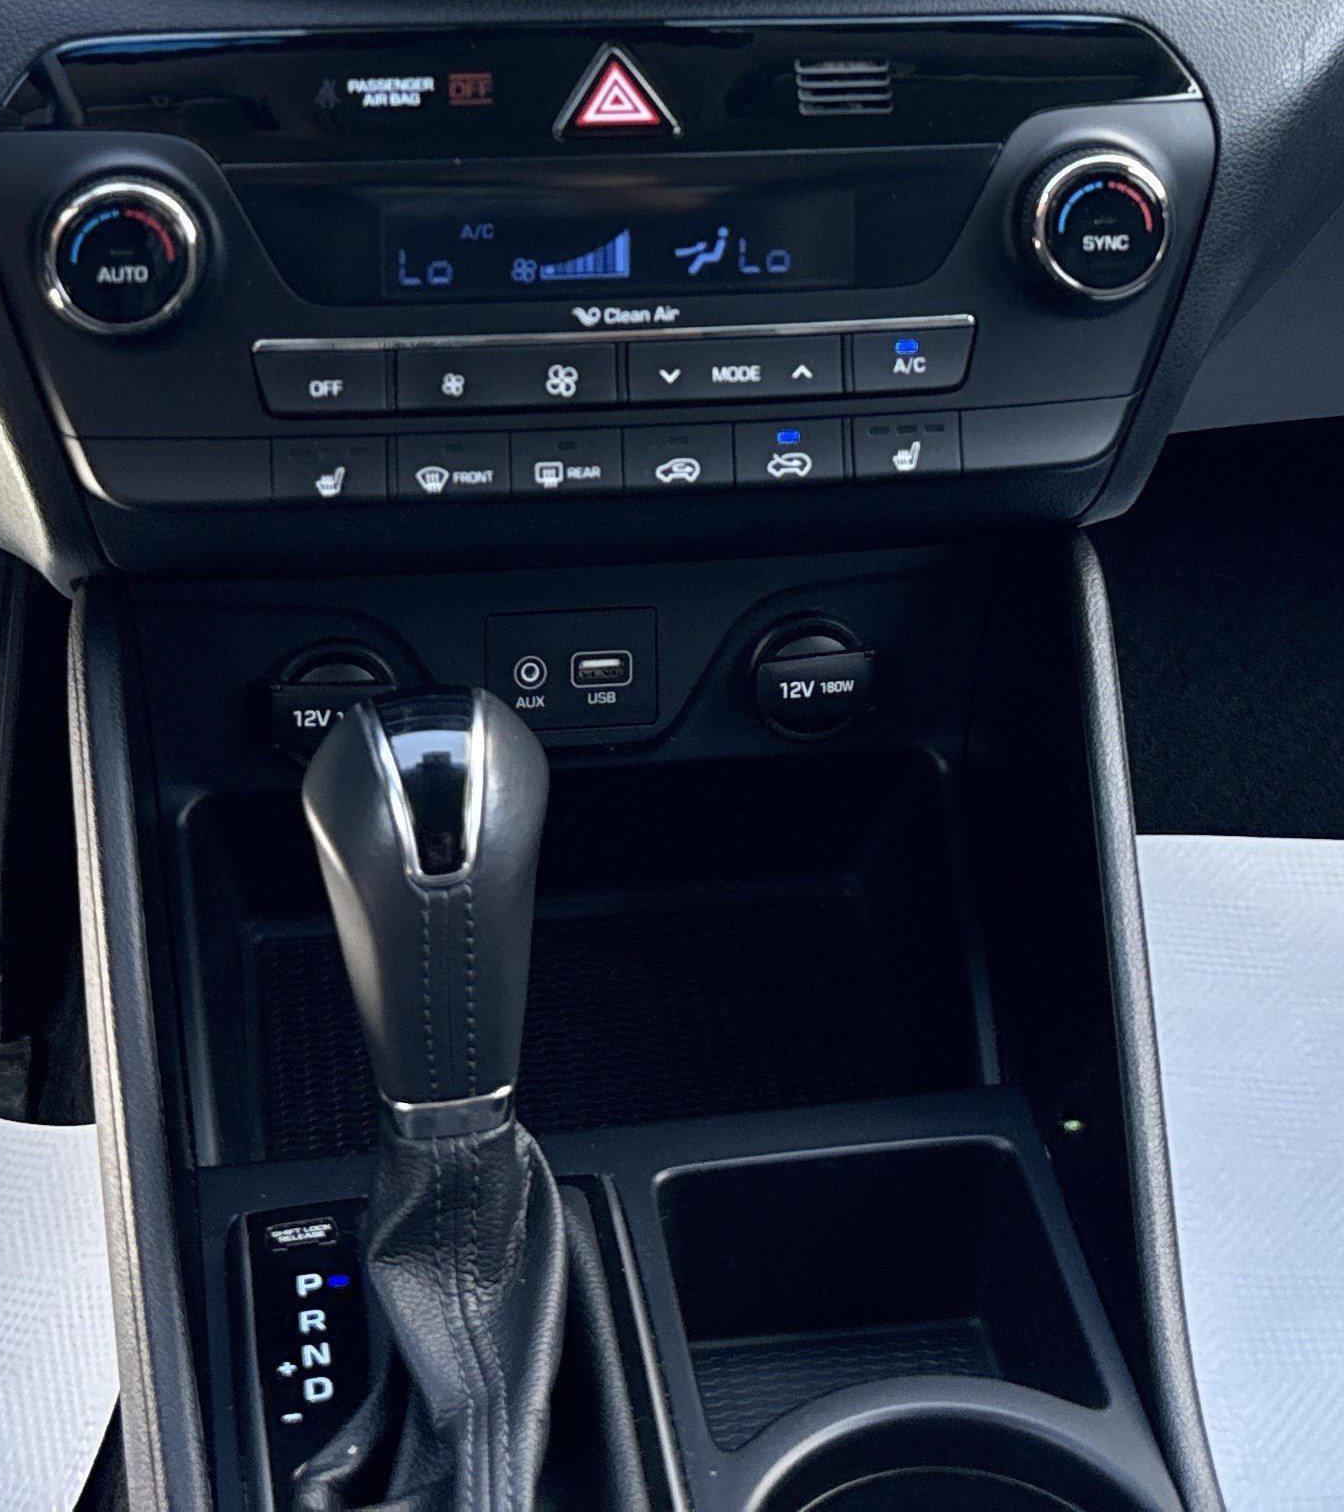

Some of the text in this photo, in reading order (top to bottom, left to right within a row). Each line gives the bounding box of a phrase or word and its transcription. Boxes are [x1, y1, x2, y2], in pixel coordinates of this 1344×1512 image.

[347, 77, 435, 94] PASSENGER
[362, 92, 421, 107] AIR BAG
[460, 224, 495, 240] A/C
[1082, 234, 1130, 252] SYNC
[96, 265, 149, 284] AUTO
[603, 306, 681, 324] Clean Air
[712, 365, 761, 383] MODE
[893, 357, 927, 375] A/C
[309, 379, 344, 397] OFF
[453, 469, 494, 484] FRONT
[567, 465, 602, 479] REAR
[586, 691, 617, 705] USB
[779, 679, 855, 699] 12V 180W
[515, 694, 545, 709] AUX
[293, 709, 332, 728] 12V
[295, 1273, 323, 1297] P
[298, 1309, 327, 1334] R
[300, 1341, 332, 1369] N
[302, 1376, 334, 1403] D
